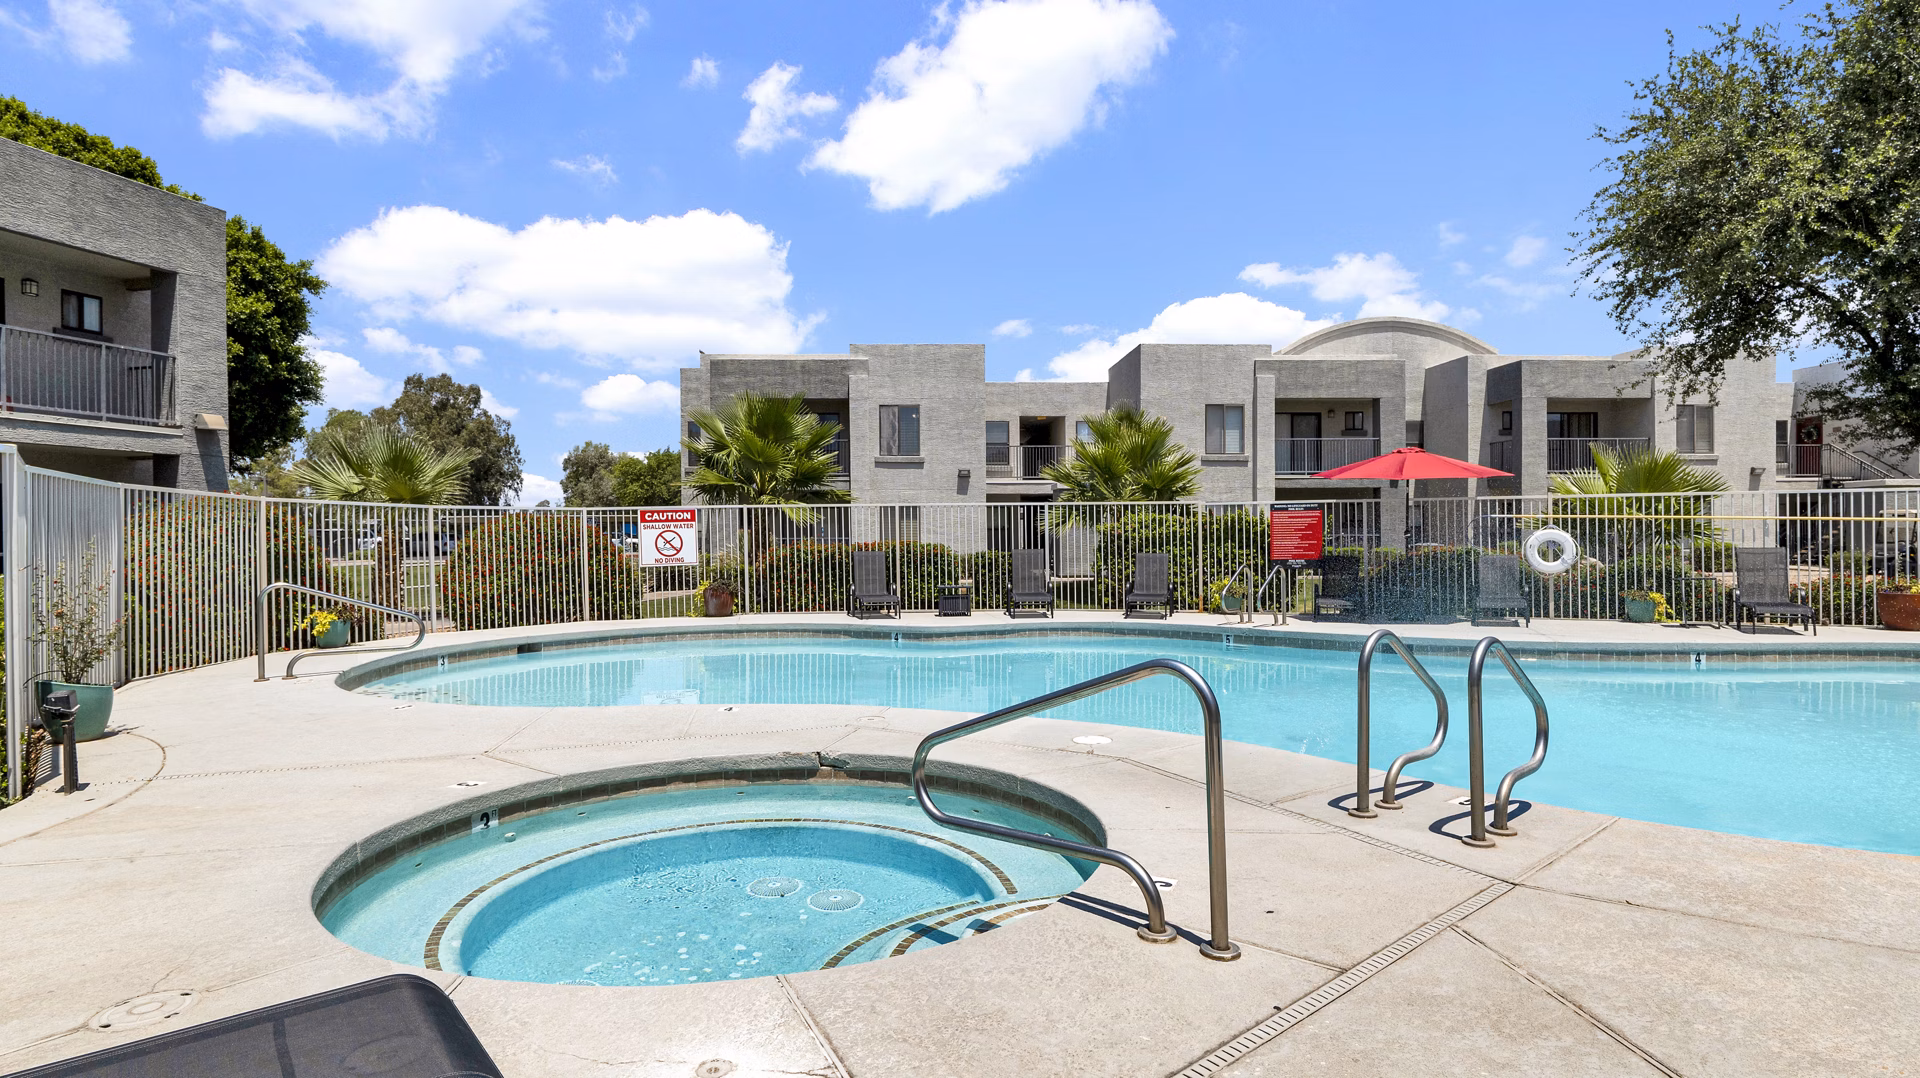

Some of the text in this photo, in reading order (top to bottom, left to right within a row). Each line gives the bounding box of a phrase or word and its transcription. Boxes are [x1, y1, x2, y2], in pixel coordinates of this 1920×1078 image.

[644, 512, 691, 520] CAUTION
[894, 632, 899, 641] 4
[1226, 635, 1230, 644] 5
[440, 655, 445, 666] 3
[1695, 652, 1701, 662] 4
[491, 809, 497, 817] FT
